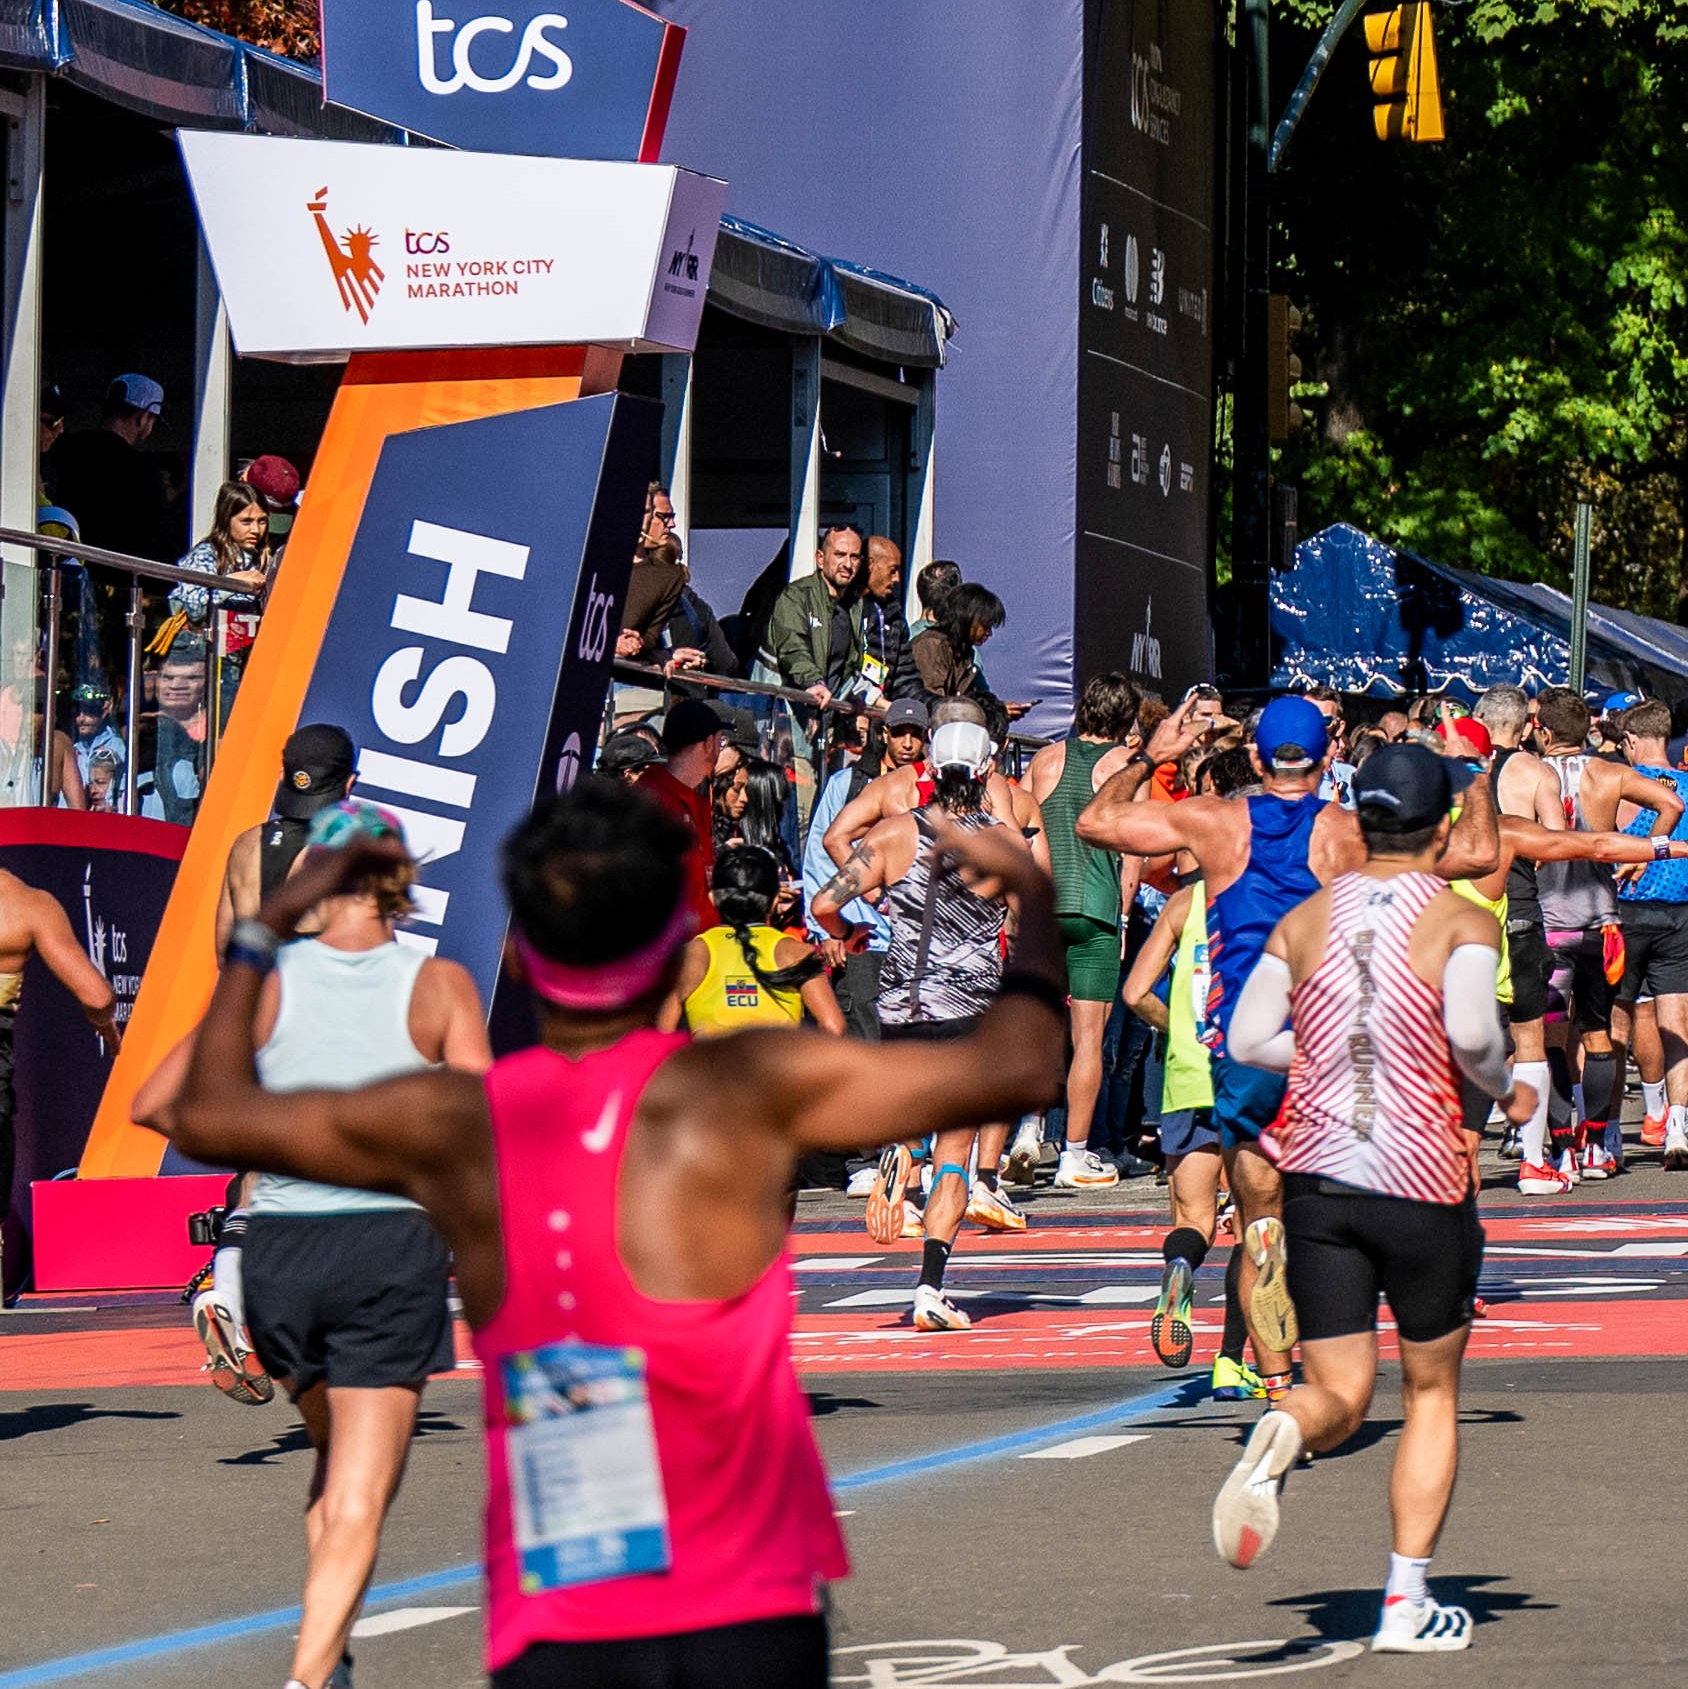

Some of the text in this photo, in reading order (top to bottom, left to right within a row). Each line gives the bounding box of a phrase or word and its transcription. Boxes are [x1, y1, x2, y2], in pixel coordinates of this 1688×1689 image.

[405, 226, 451, 255] tcs
[406, 258, 554, 278] NEW YORK CITY
[406, 281, 518, 299] MARATHON
[578, 569, 615, 663] tcs
[726, 995, 759, 1007] ECU
